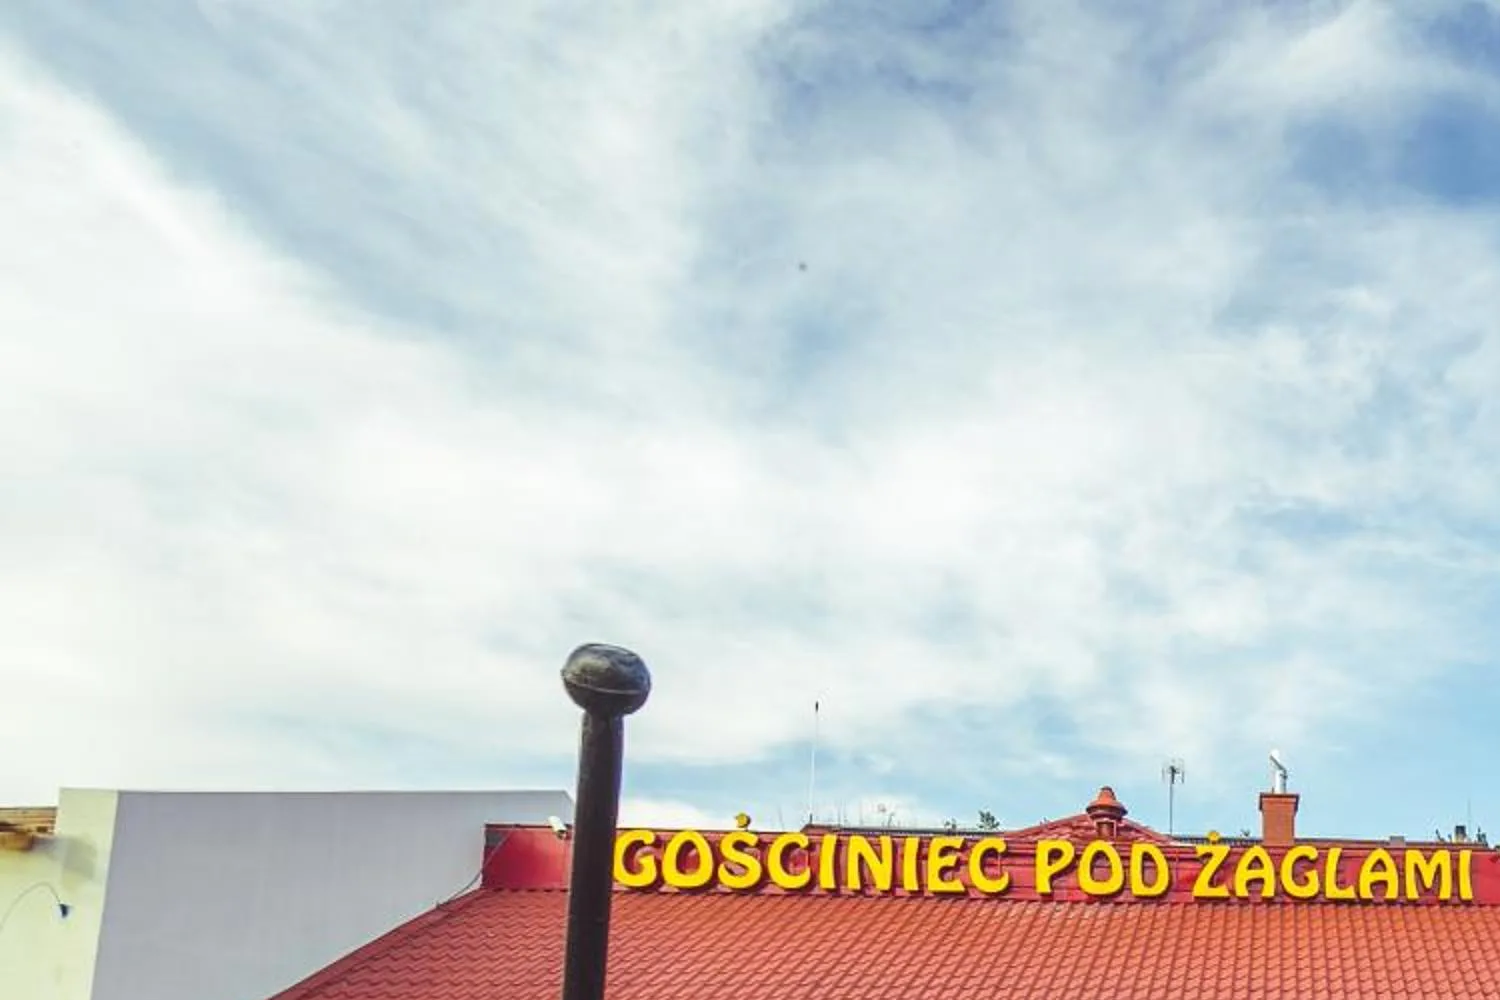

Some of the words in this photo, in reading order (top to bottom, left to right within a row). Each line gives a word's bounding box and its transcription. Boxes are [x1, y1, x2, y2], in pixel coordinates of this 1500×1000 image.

[612, 812, 1010, 893] GOŚCINIEC
[1034, 839, 1171, 896] POD
[1192, 832, 1474, 901] ŻAGLAMI
